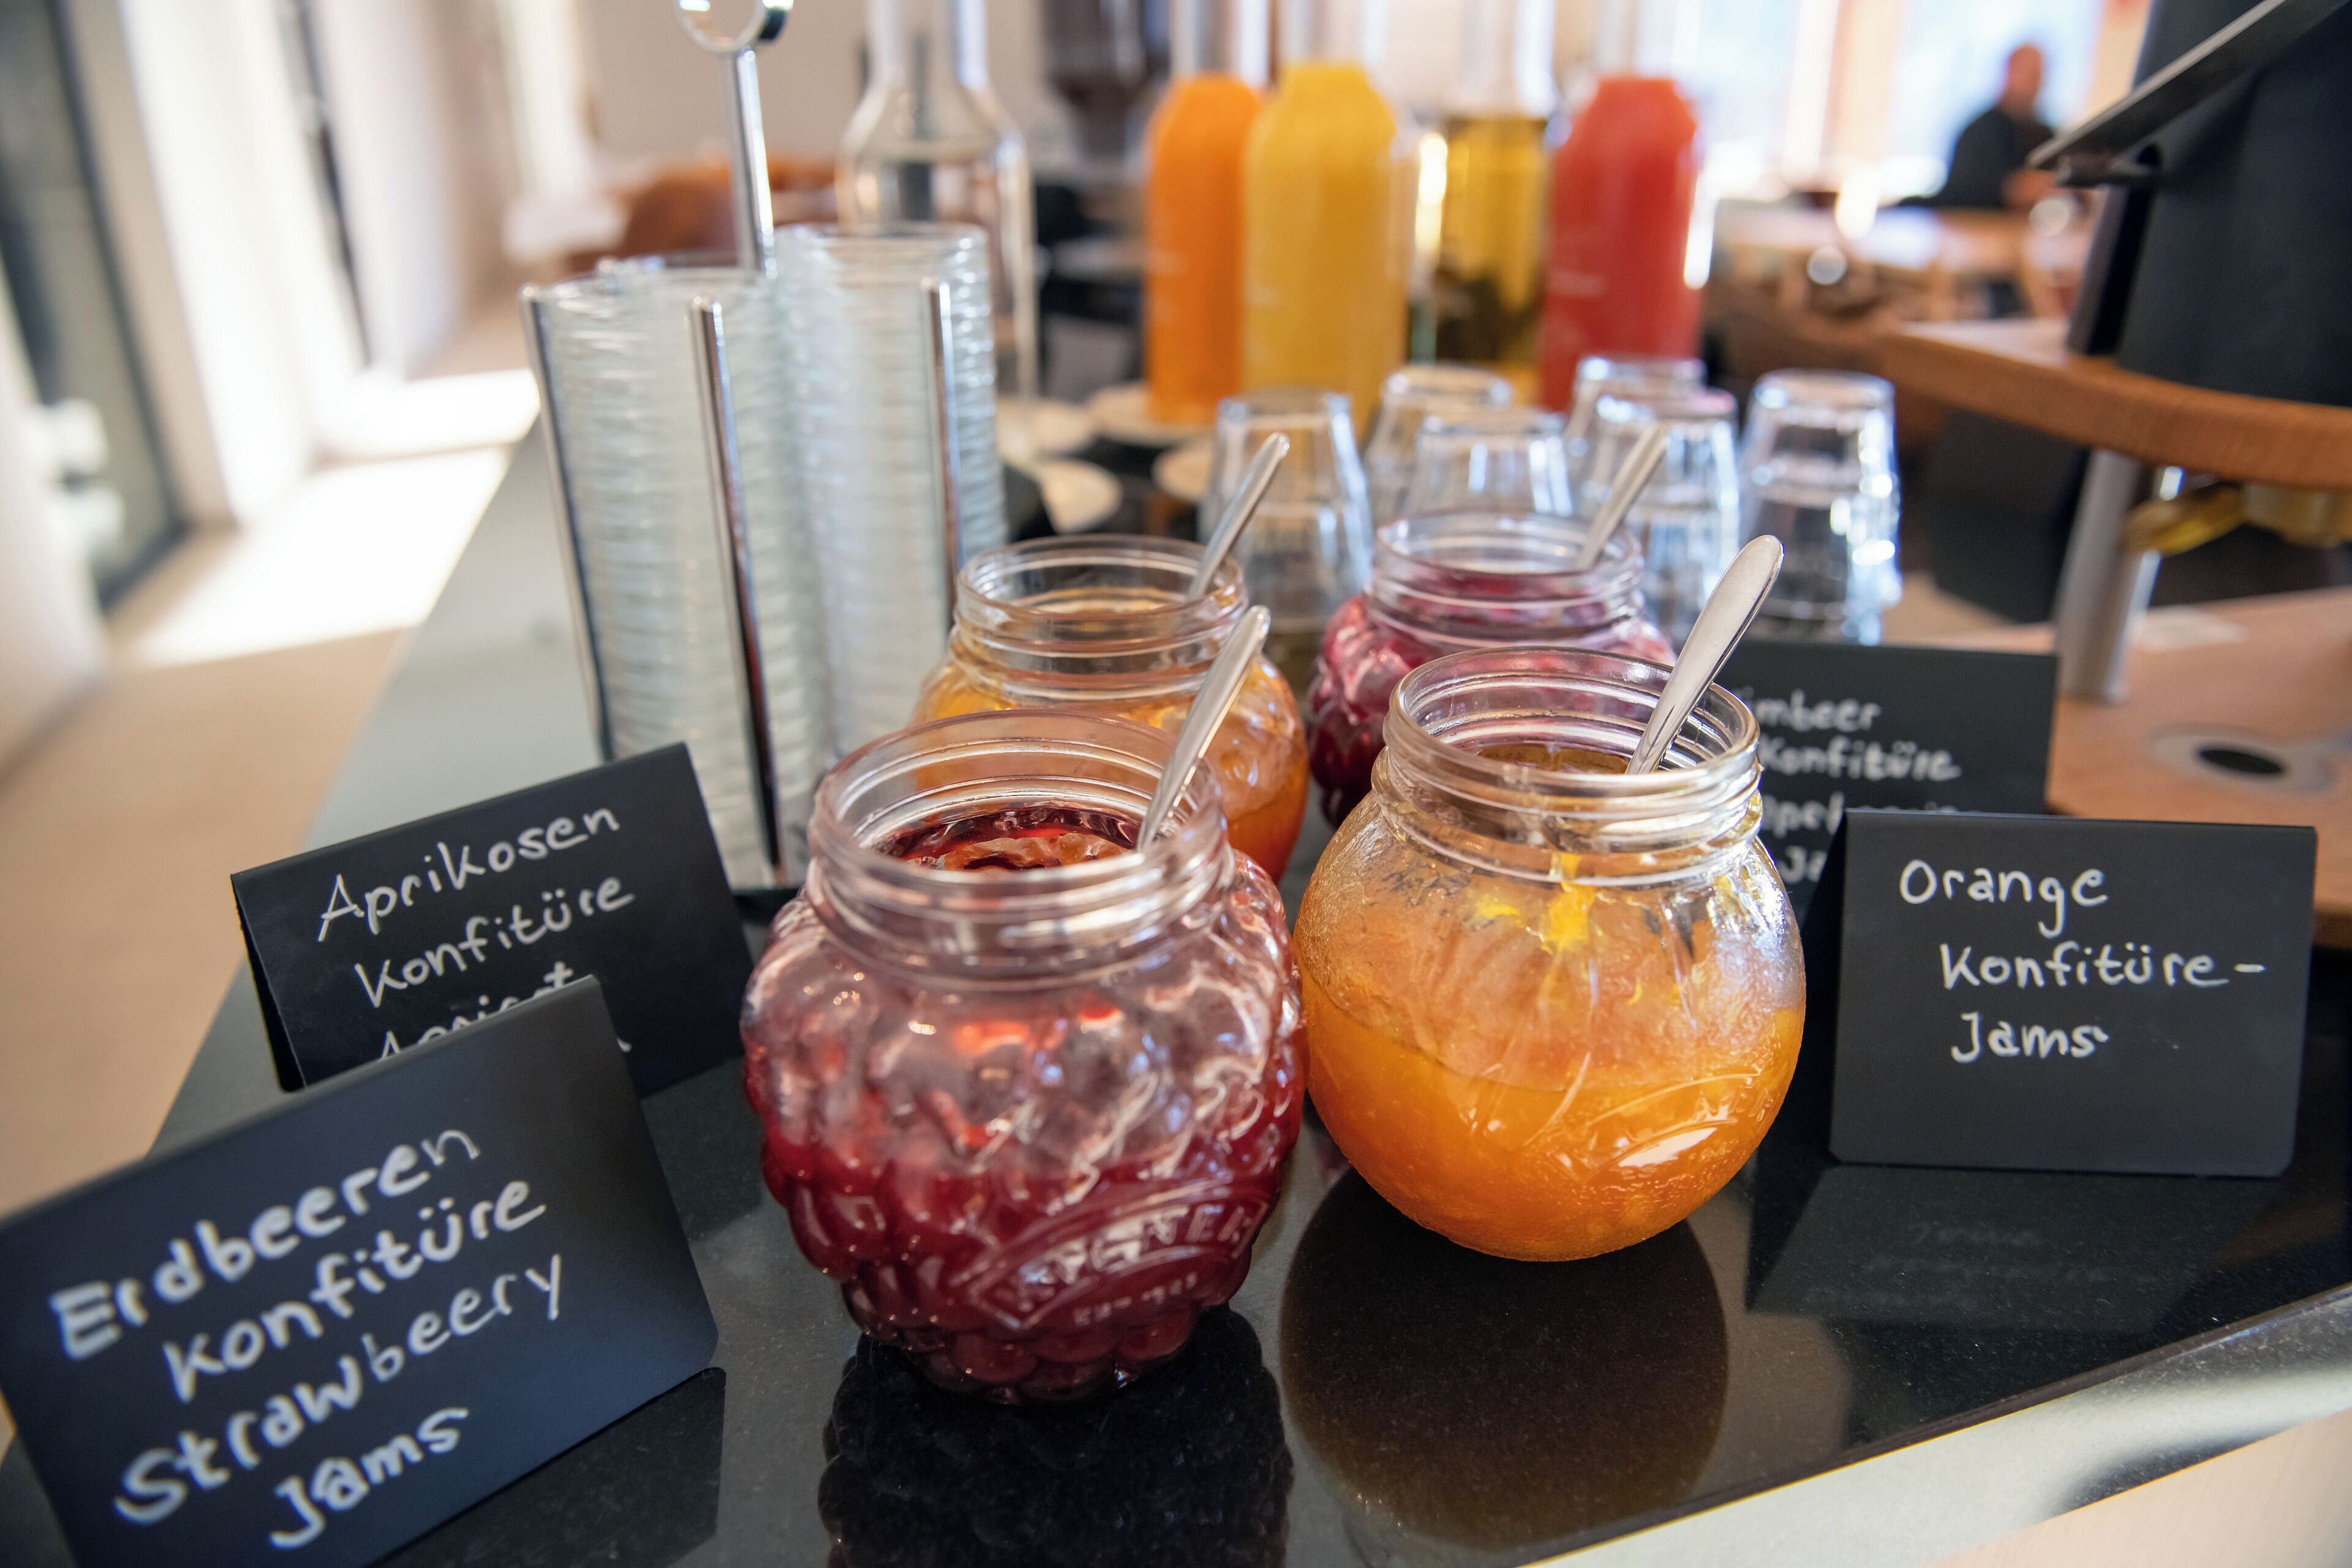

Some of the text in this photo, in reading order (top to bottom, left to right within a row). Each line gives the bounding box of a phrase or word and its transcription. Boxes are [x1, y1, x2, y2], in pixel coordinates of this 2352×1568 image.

[318, 808, 620, 942] Aprikosen
[354, 877, 635, 1008] Konfitüre
[1899, 859, 2108, 938] Orange
[1951, 1012, 2109, 1063] Jams
[51, 1129, 480, 1357] Erdbeeren
[164, 1181, 546, 1401] Konfitüre
[116, 1253, 562, 1522] Strawbeery
[271, 1407, 469, 1548] Jams
